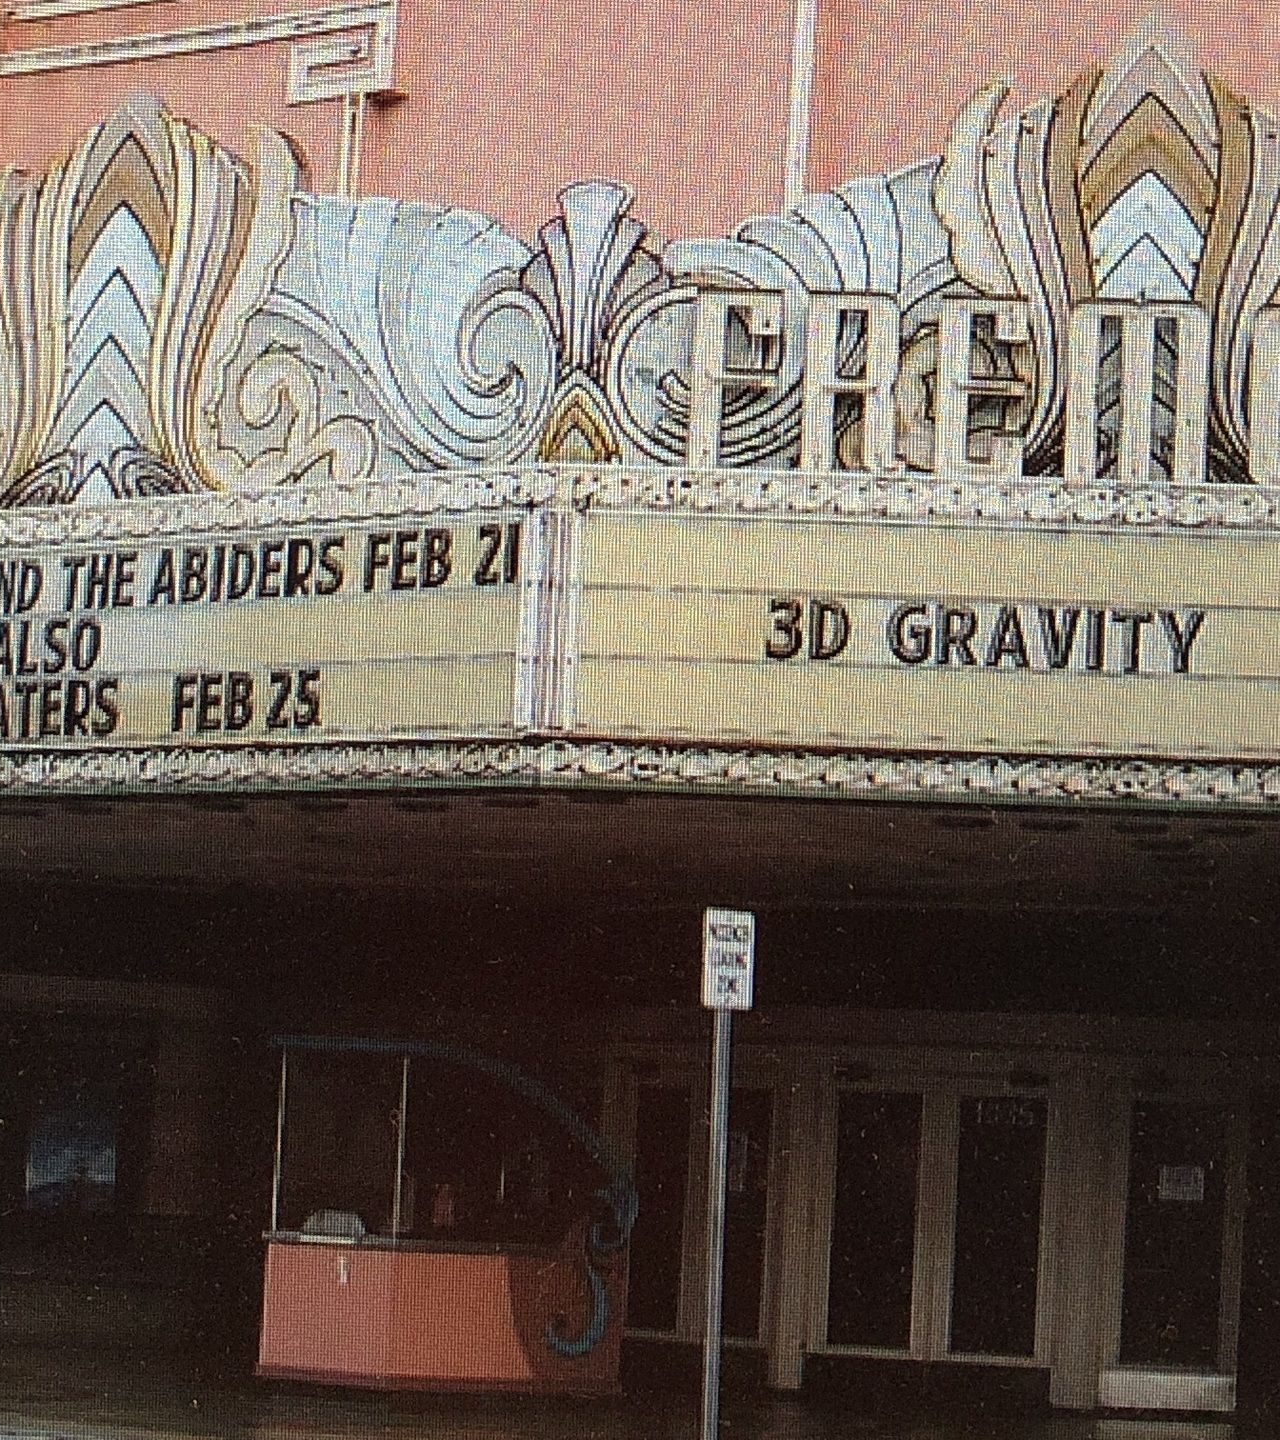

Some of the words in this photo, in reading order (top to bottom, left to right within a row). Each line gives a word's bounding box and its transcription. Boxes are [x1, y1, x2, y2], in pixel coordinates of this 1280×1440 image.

[62, 549, 138, 614] THE
[150, 535, 345, 605] ABIDERS
[363, 526, 453, 593] FEB
[474, 522, 520, 587] 21
[764, 597, 851, 662] 3D
[890, 602, 1207, 675] GRAVITY
[171, 670, 255, 733] FEB
[266, 668, 322, 730] 25
